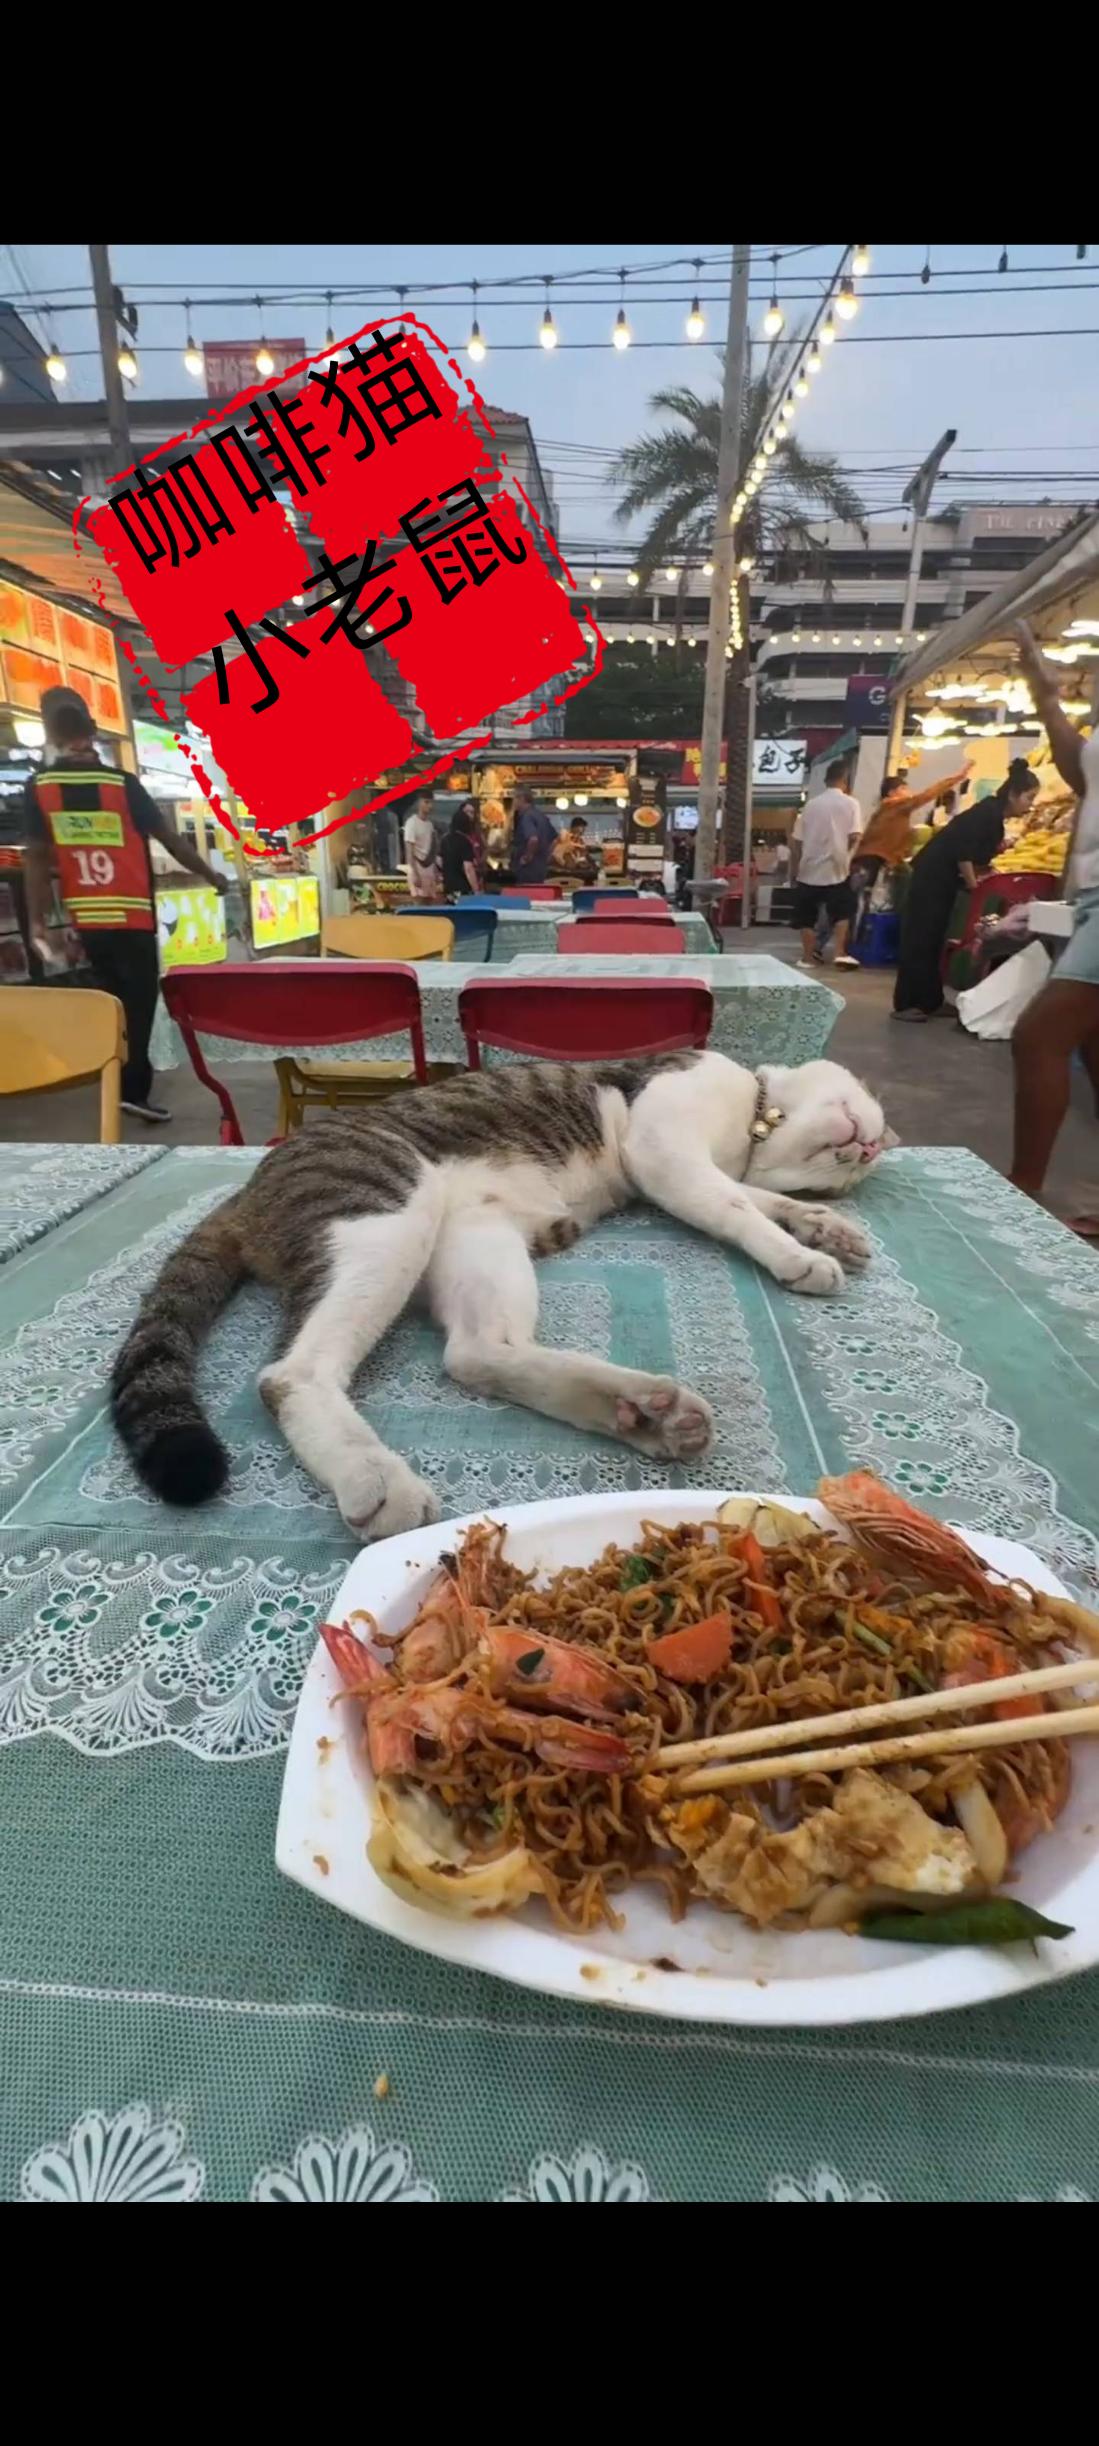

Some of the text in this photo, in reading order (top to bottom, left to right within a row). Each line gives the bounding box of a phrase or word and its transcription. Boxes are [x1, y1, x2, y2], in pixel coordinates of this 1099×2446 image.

[868, 685, 888, 706] G
[753, 745, 810, 775] 包子
[71, 849, 115, 886] 19
[377, 881, 412, 892] CROCO
